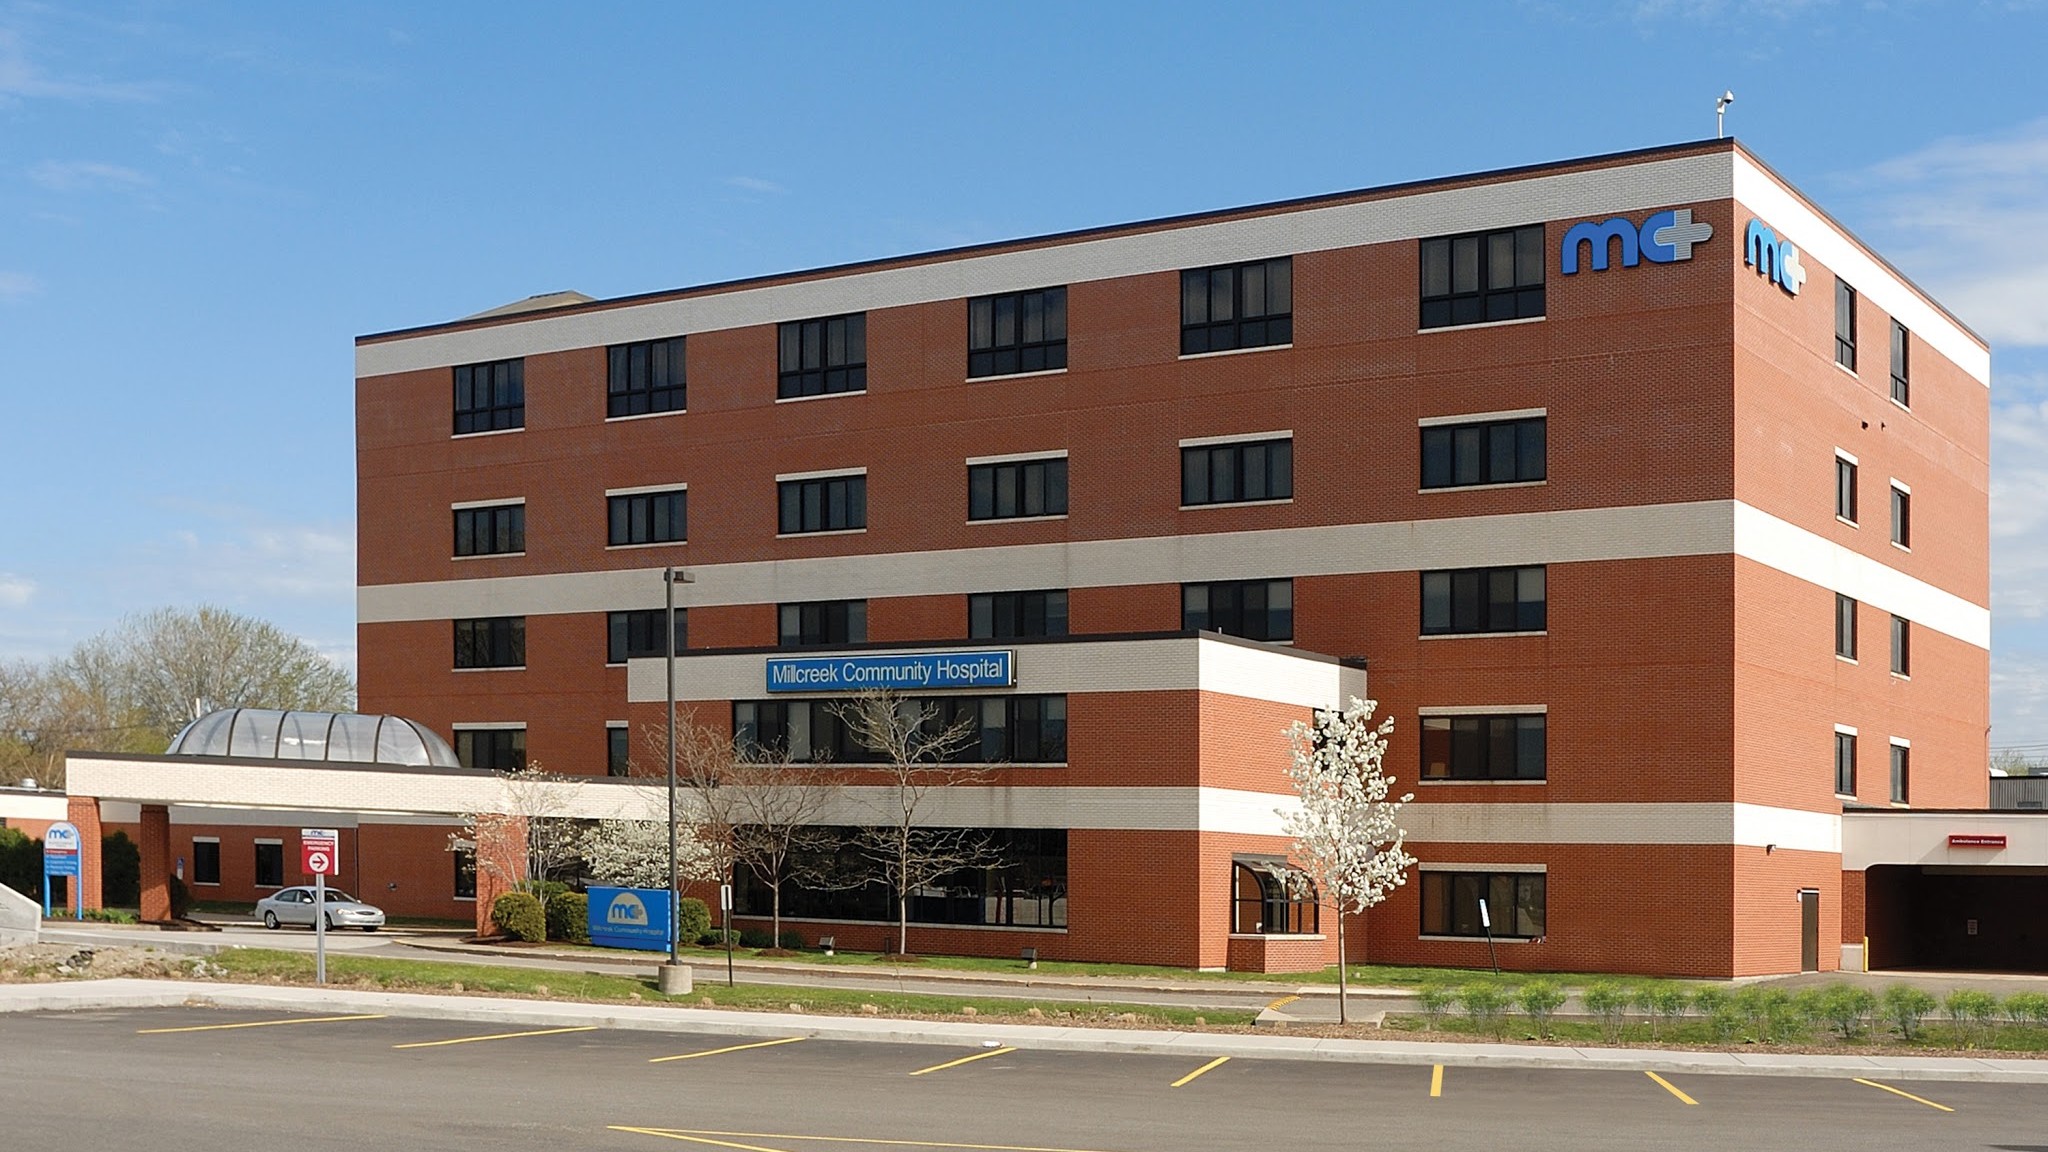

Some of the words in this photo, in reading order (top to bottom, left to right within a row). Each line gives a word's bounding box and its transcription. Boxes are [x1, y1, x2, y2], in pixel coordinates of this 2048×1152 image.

[773, 664, 838, 684] Millcreek
[842, 660, 932, 685] Community
[936, 658, 1003, 682] Hospital
